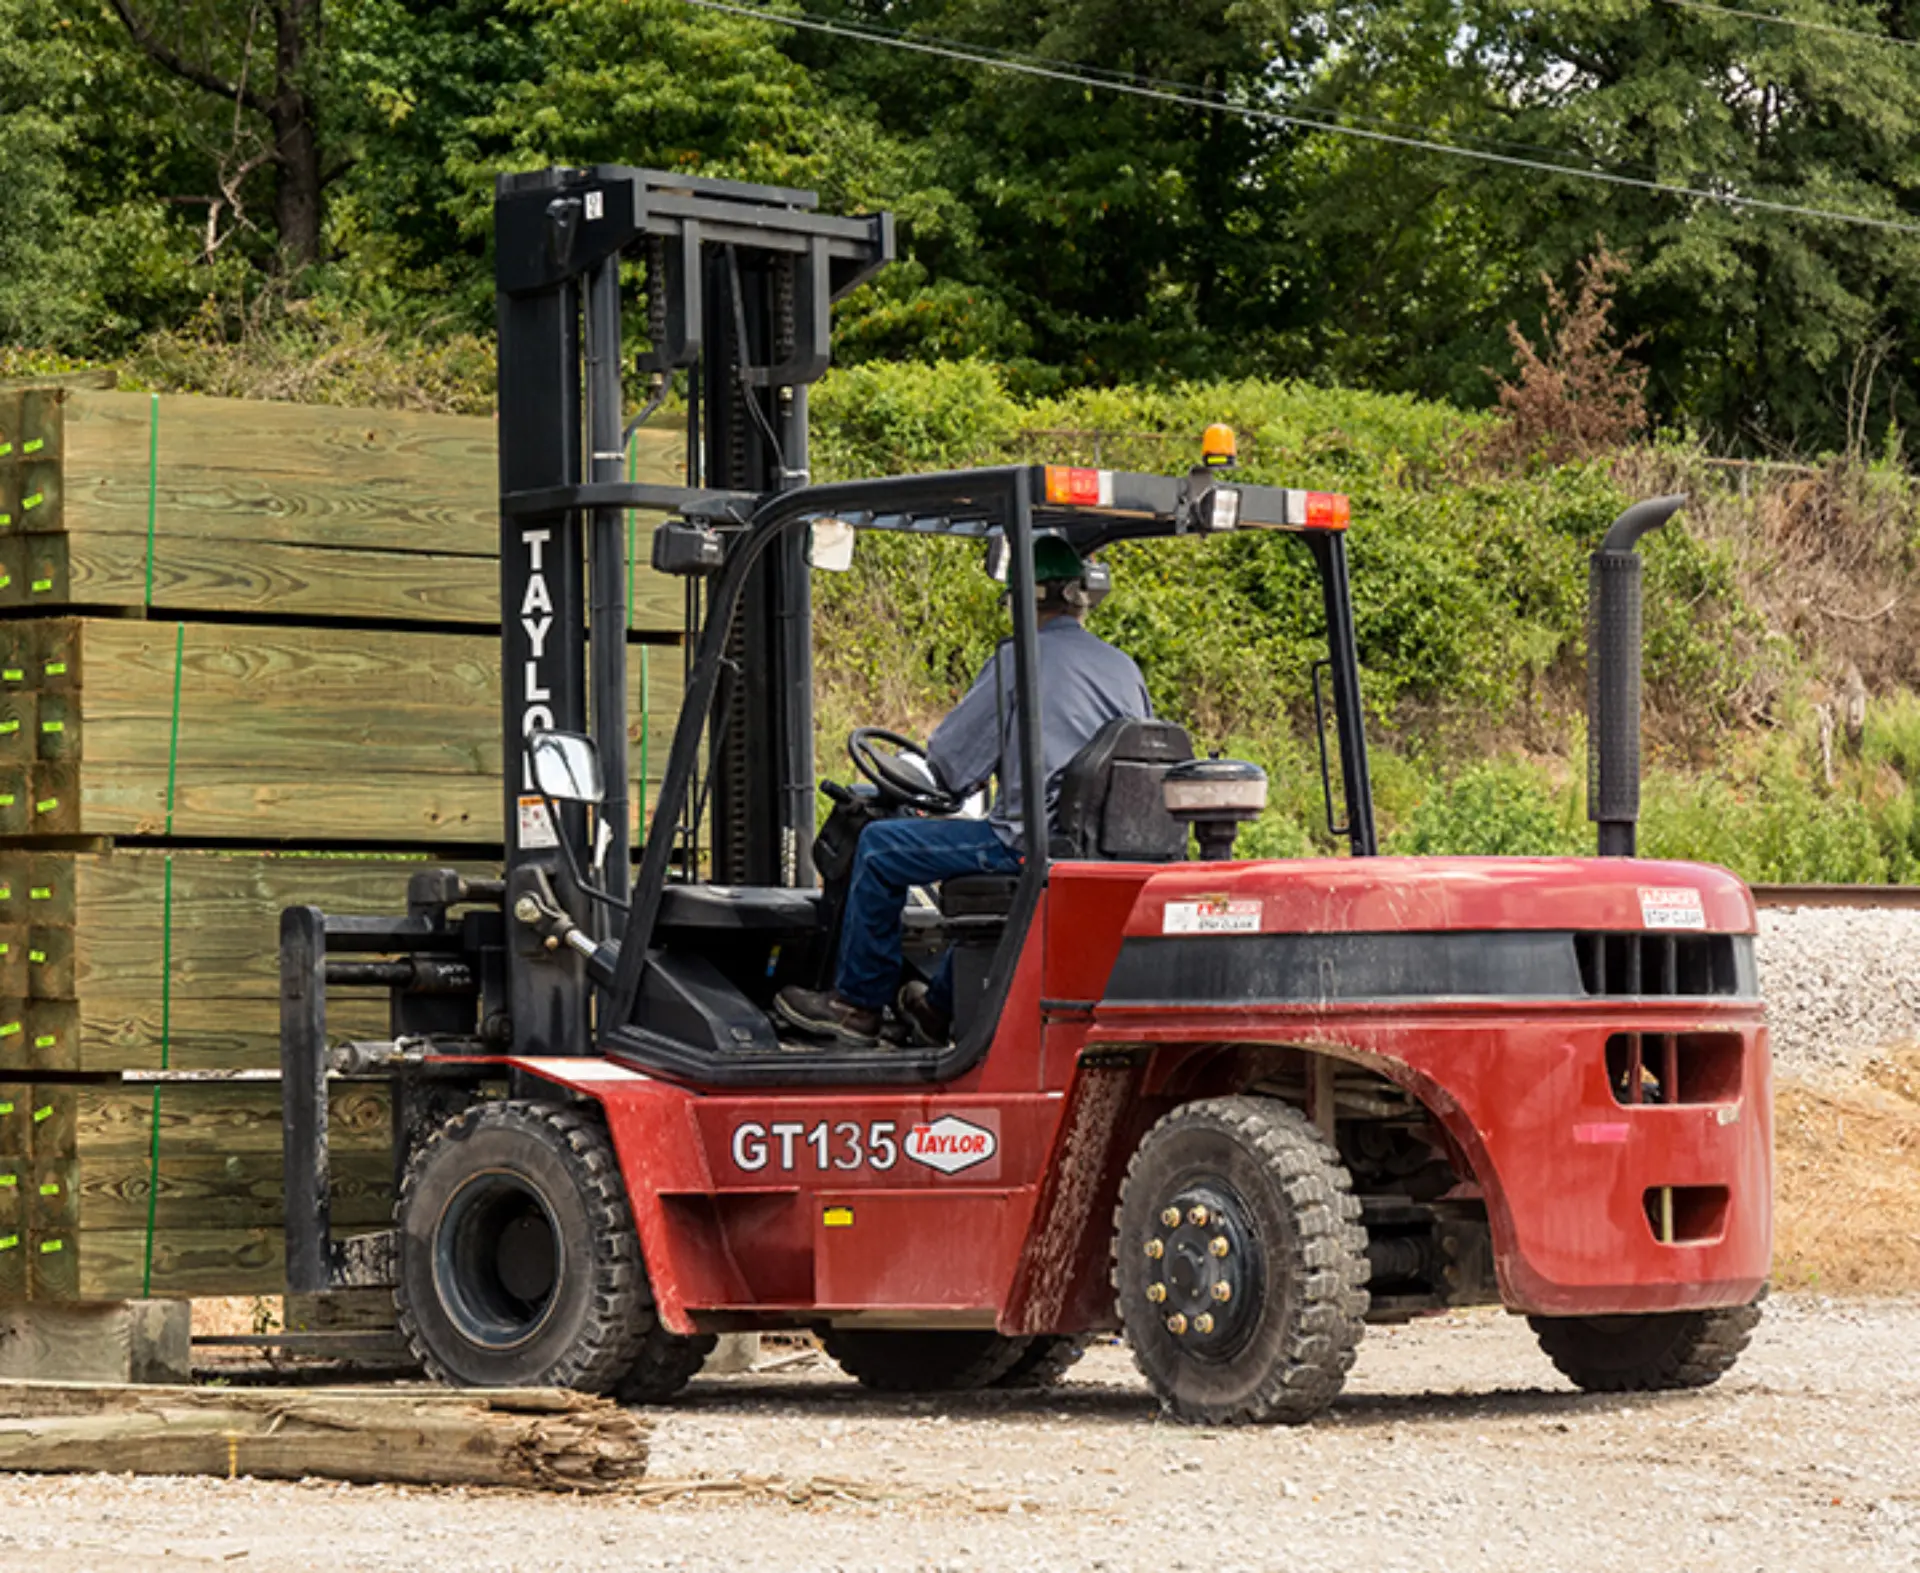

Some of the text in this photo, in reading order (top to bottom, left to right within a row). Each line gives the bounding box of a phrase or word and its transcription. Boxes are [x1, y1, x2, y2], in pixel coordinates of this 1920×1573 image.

[521, 529, 553, 790] TAYLO
[731, 1120, 898, 1170] GT135
[914, 1126, 986, 1153] TAYLOR
